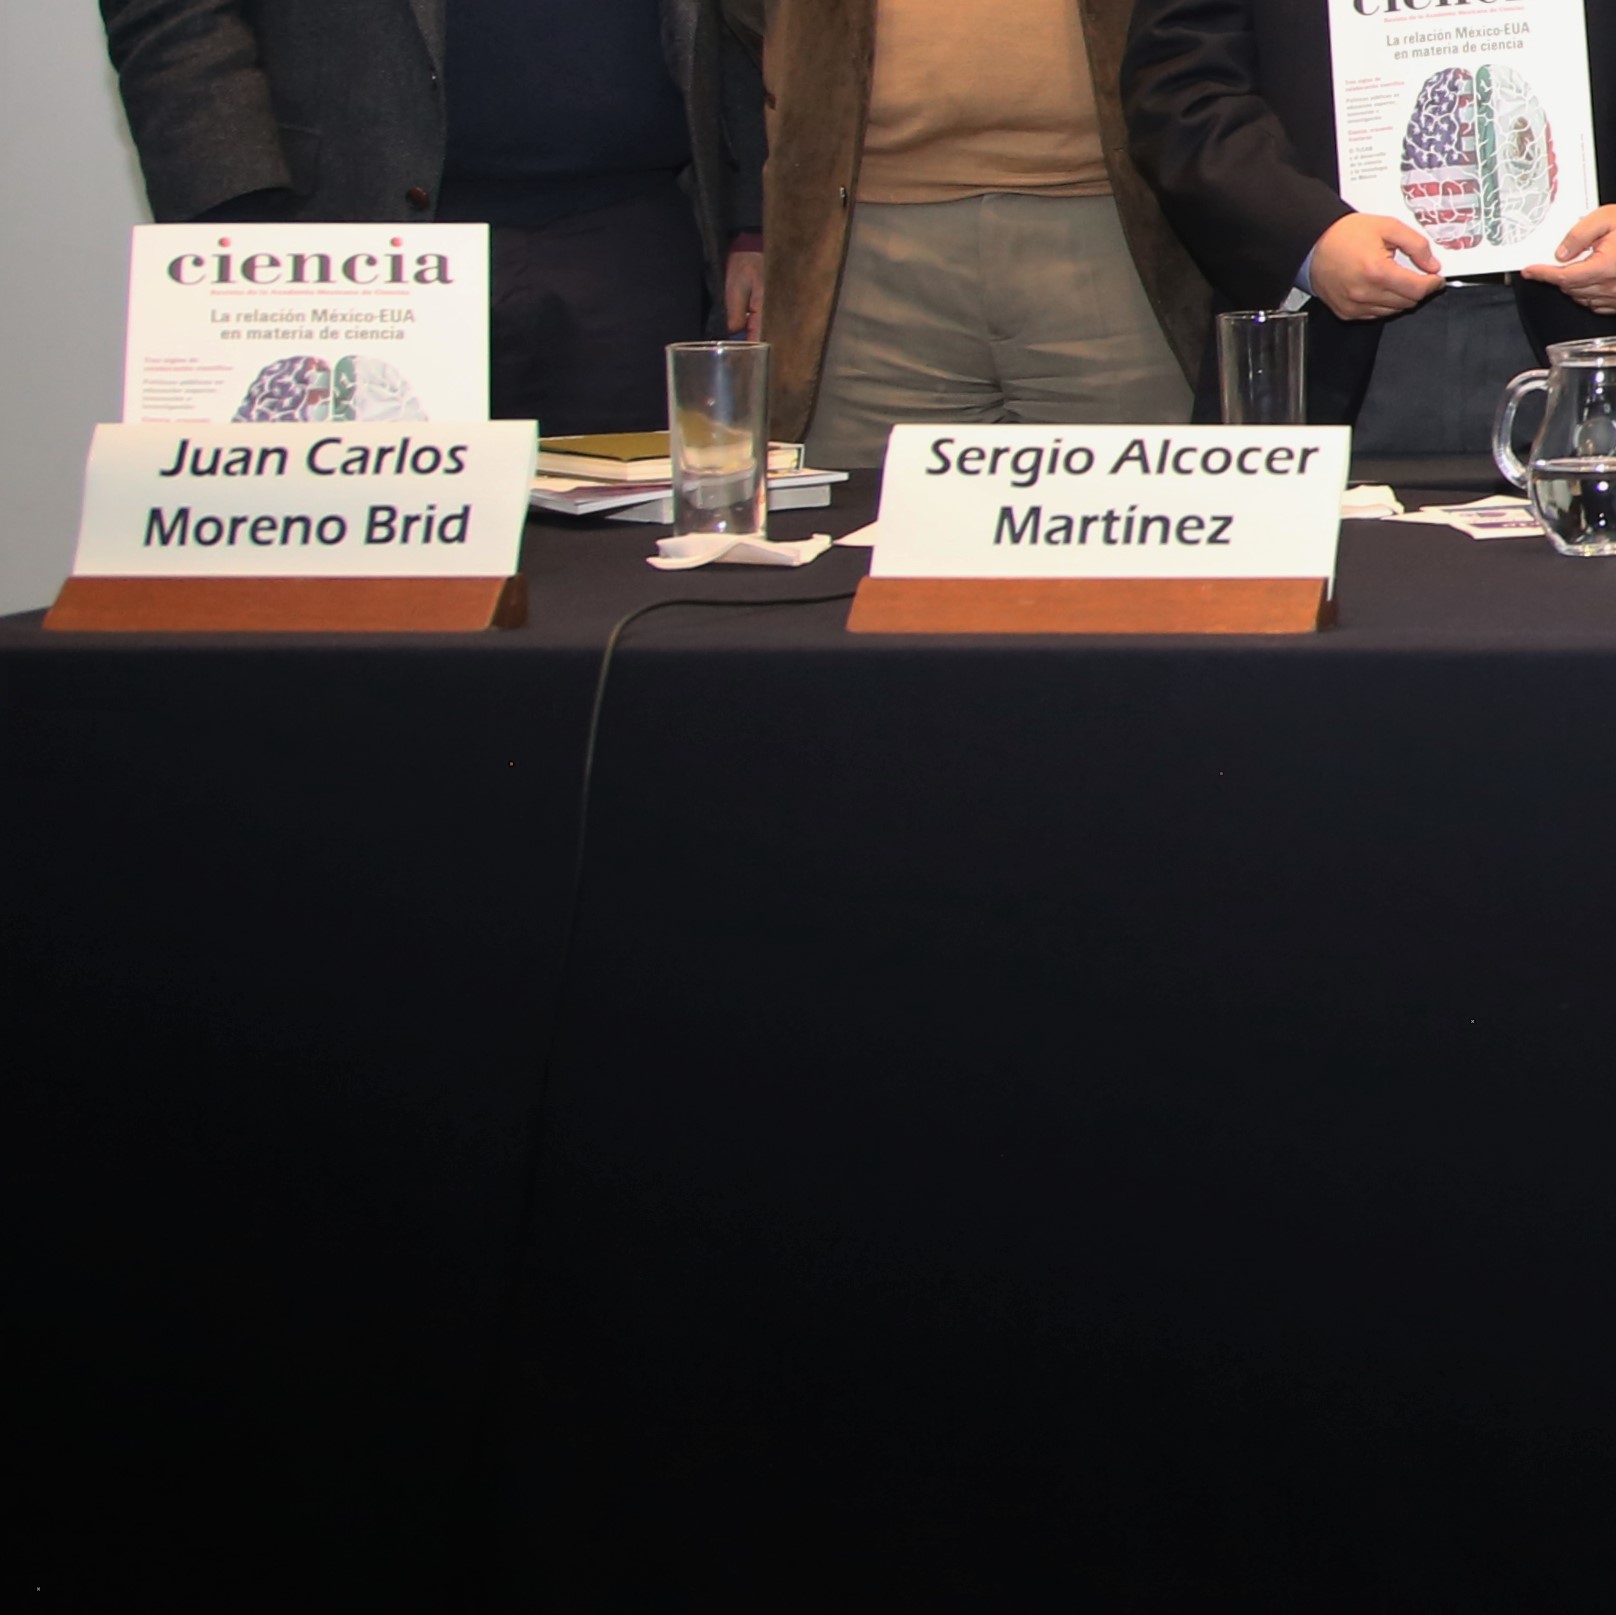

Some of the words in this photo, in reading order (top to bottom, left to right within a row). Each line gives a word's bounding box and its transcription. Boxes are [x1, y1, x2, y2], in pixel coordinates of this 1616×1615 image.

[1386, 35, 1400, 47] La
[1403, 30, 1452, 45] relación
[1394, 49, 1408, 60] en
[1412, 44, 1459, 58] materia
[1462, 42, 1477, 53] de
[1480, 37, 1524, 52] ciencia
[167, 237, 454, 285] ciencia
[210, 309, 231, 323] La
[236, 308, 306, 323] relación
[221, 328, 242, 340] en
[247, 326, 314, 340] materia
[319, 326, 339, 340] de
[344, 326, 405, 340] ciencia
[159, 438, 289, 477] Juan
[305, 436, 469, 476] Carlos
[925, 437, 1095, 488] Sergio
[1107, 438, 1320, 476] Alcocer
[143, 505, 347, 547] Moreno
[363, 503, 472, 545] Brid
[992, 504, 1234, 546] Martínez
